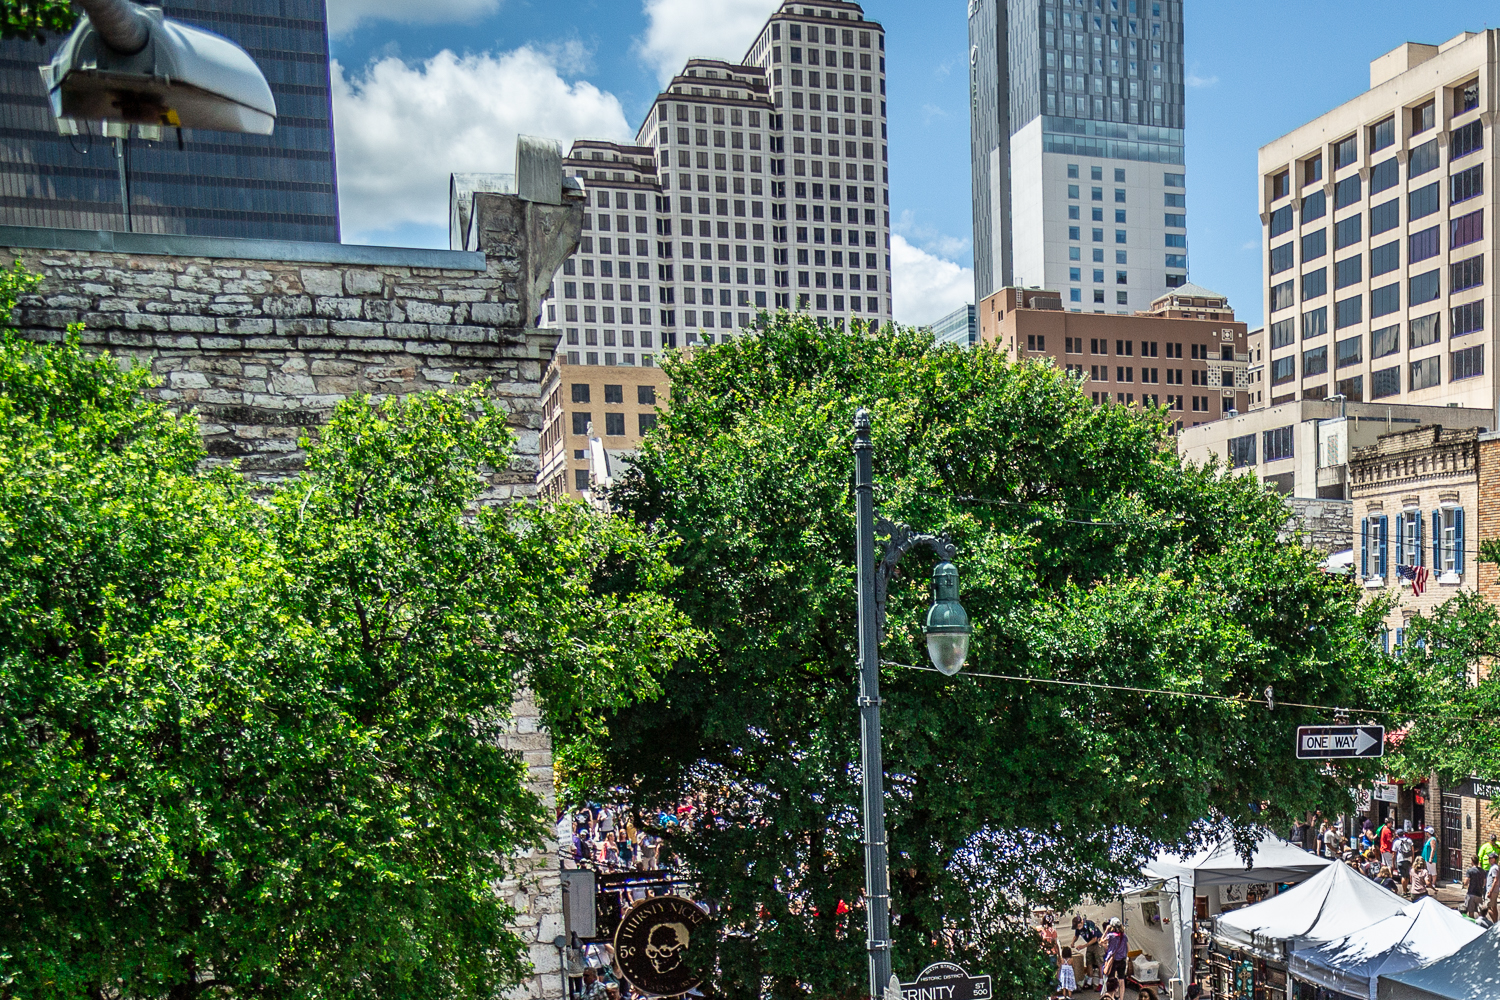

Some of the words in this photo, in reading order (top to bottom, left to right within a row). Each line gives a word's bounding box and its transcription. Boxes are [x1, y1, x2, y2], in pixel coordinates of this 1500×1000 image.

[1306, 737, 1328, 748] ONE
[1334, 737, 1358, 748] WAY
[623, 902, 664, 938] THIRSTY
[925, 965, 939, 975] SIXTH
[940, 964, 959, 972] STREET
[974, 982, 986, 990] ST
[973, 988, 988, 996] 500
